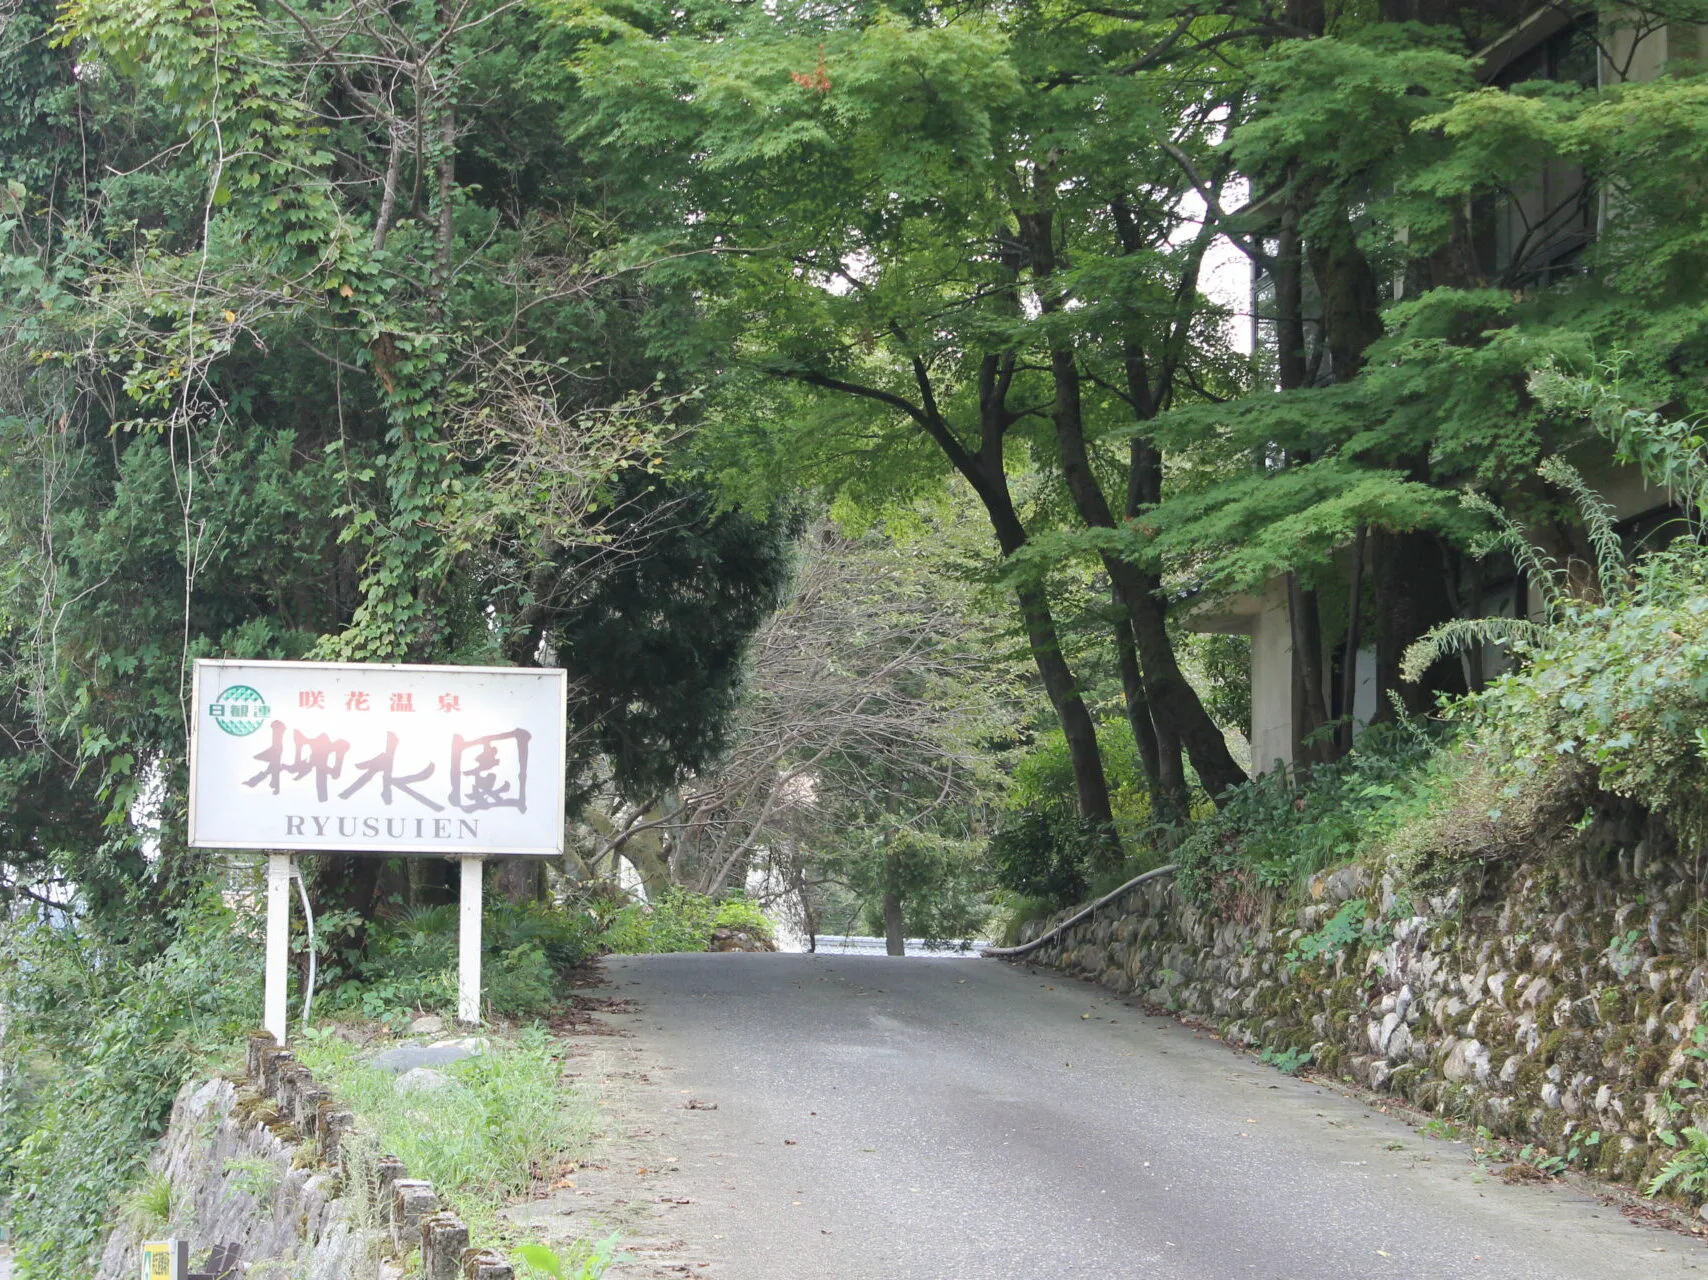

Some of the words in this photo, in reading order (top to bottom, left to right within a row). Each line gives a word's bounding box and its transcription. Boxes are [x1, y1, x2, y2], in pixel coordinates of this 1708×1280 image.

[299, 691, 463, 713] 咲花温泉
[242, 720, 532, 814] 柳水園
[286, 815, 480, 839] RYUSUIEN
